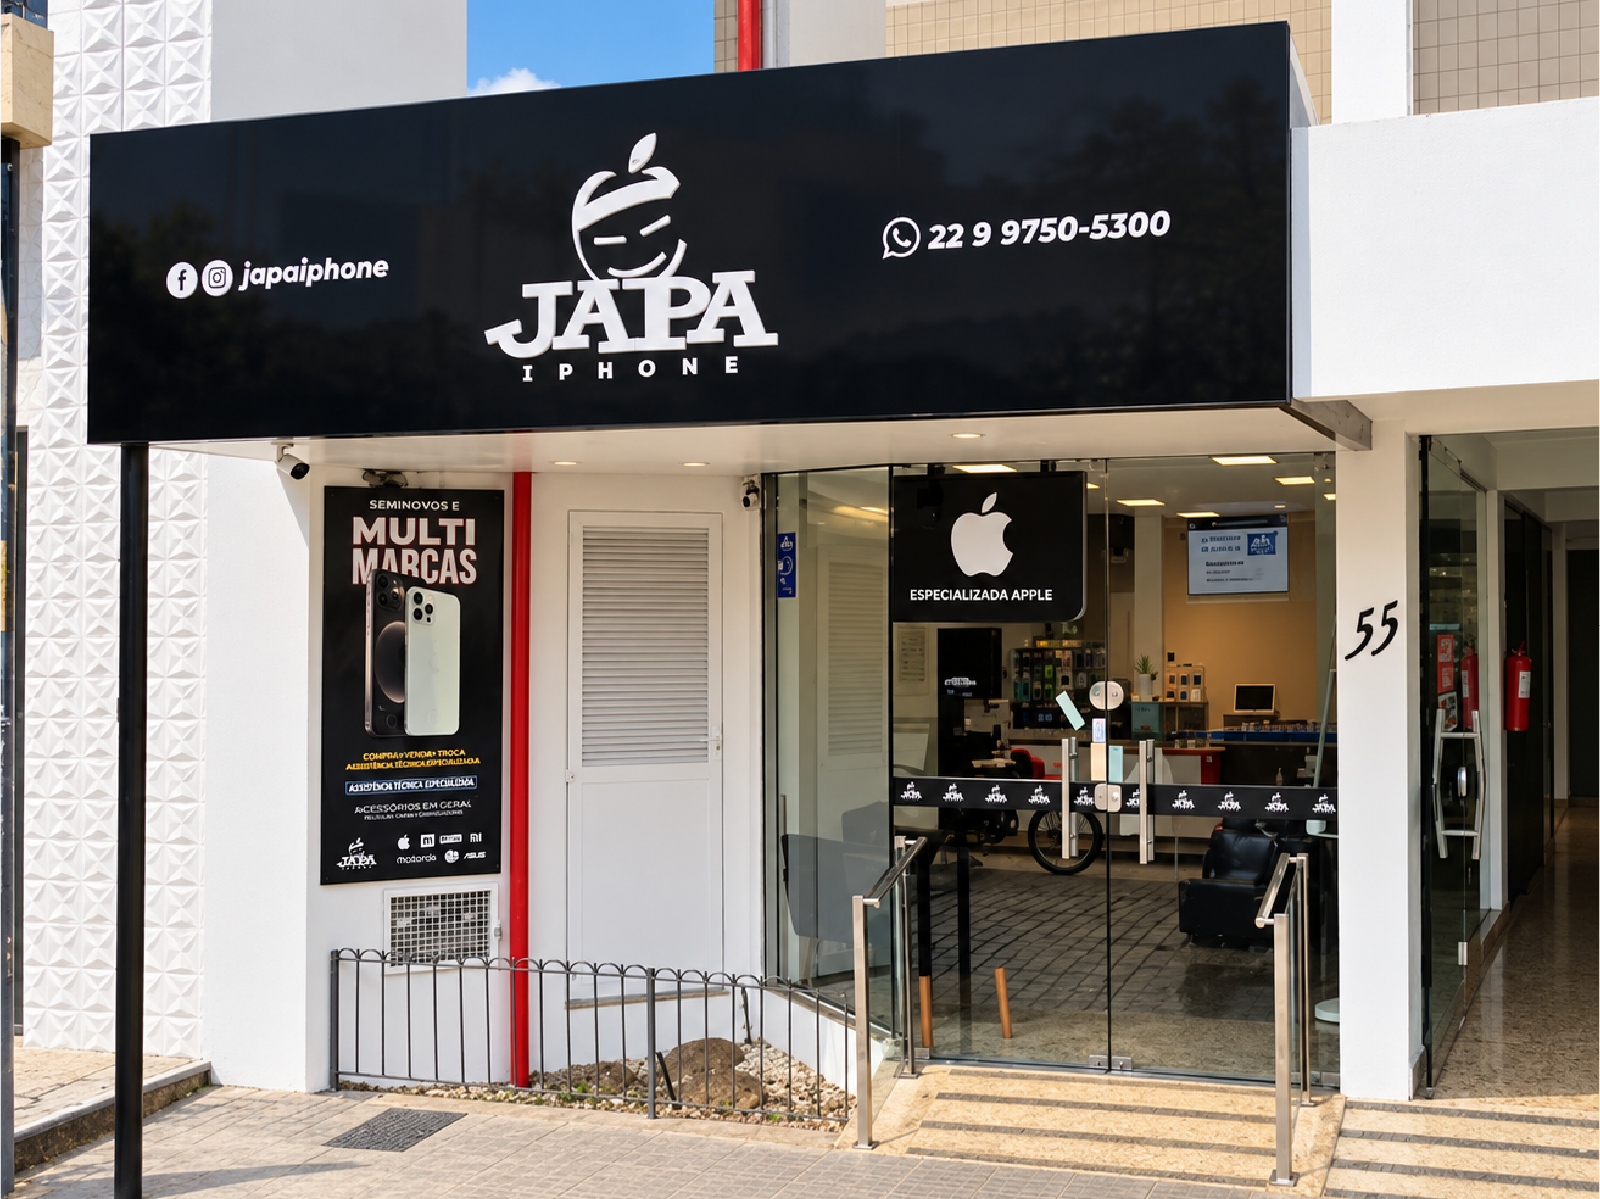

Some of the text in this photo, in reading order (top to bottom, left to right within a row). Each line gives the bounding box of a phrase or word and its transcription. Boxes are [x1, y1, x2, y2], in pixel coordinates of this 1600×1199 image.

[928, 210, 1171, 250] 22 9 9750-5300
[238, 257, 389, 291] japaiphone
[484, 270, 779, 358] JAPA
[522, 356, 739, 383] IPHONE
[369, 500, 460, 512] SEMINOVOS E
[352, 516, 476, 546] MULTI
[352, 547, 477, 585] MARCAS
[910, 589, 1053, 601] ESPECIALIZADA APPLE
[1344, 600, 1398, 661] 55
